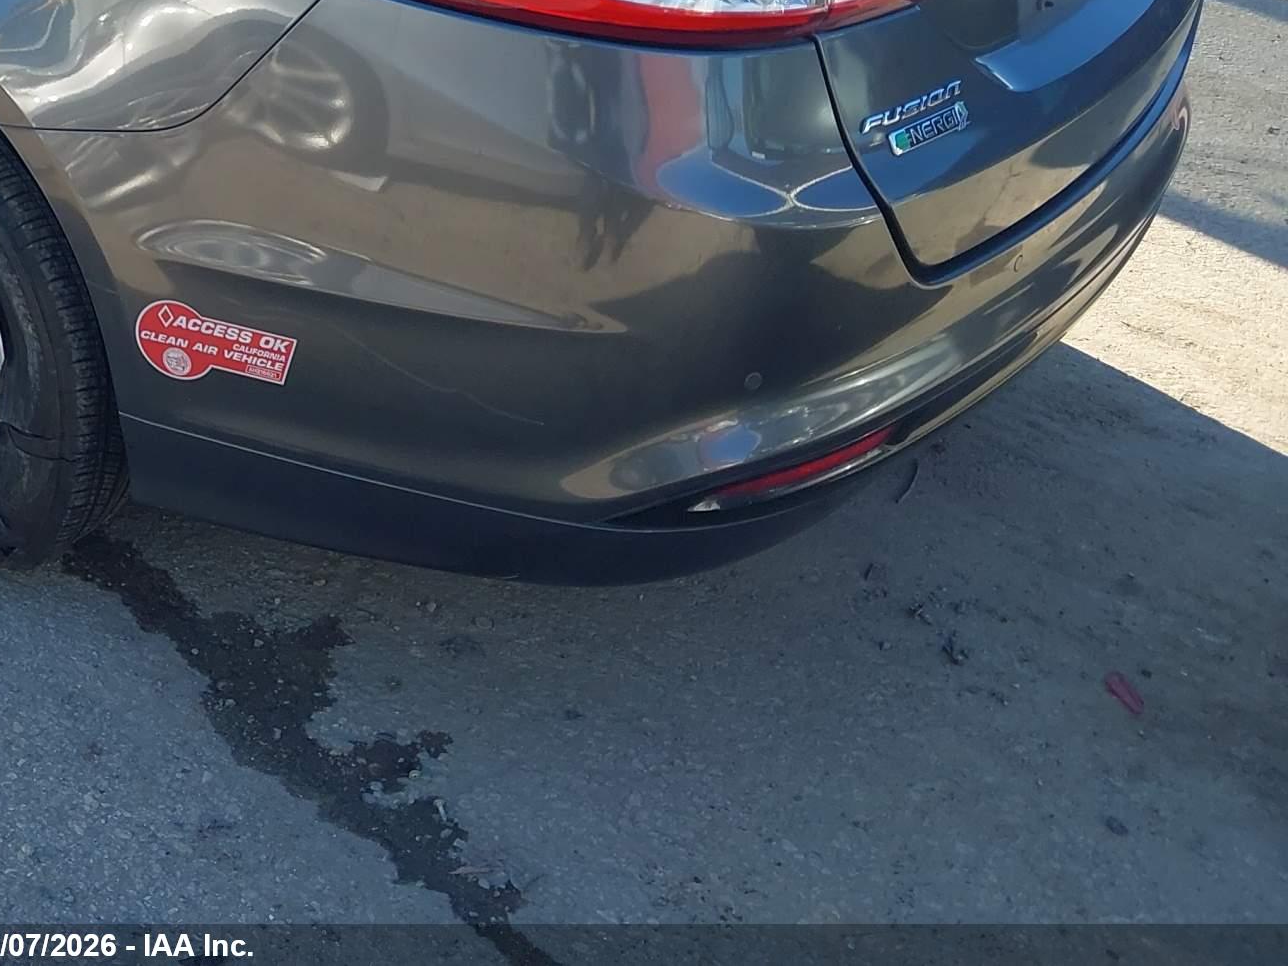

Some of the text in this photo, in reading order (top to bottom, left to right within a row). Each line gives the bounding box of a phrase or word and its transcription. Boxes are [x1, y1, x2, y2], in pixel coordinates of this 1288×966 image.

[140, 330, 284, 371] CLEAN AIR VEHICLE
[173, 315, 291, 353] ACCESS OK
[232, 343, 286, 362] CALIFORNIA
